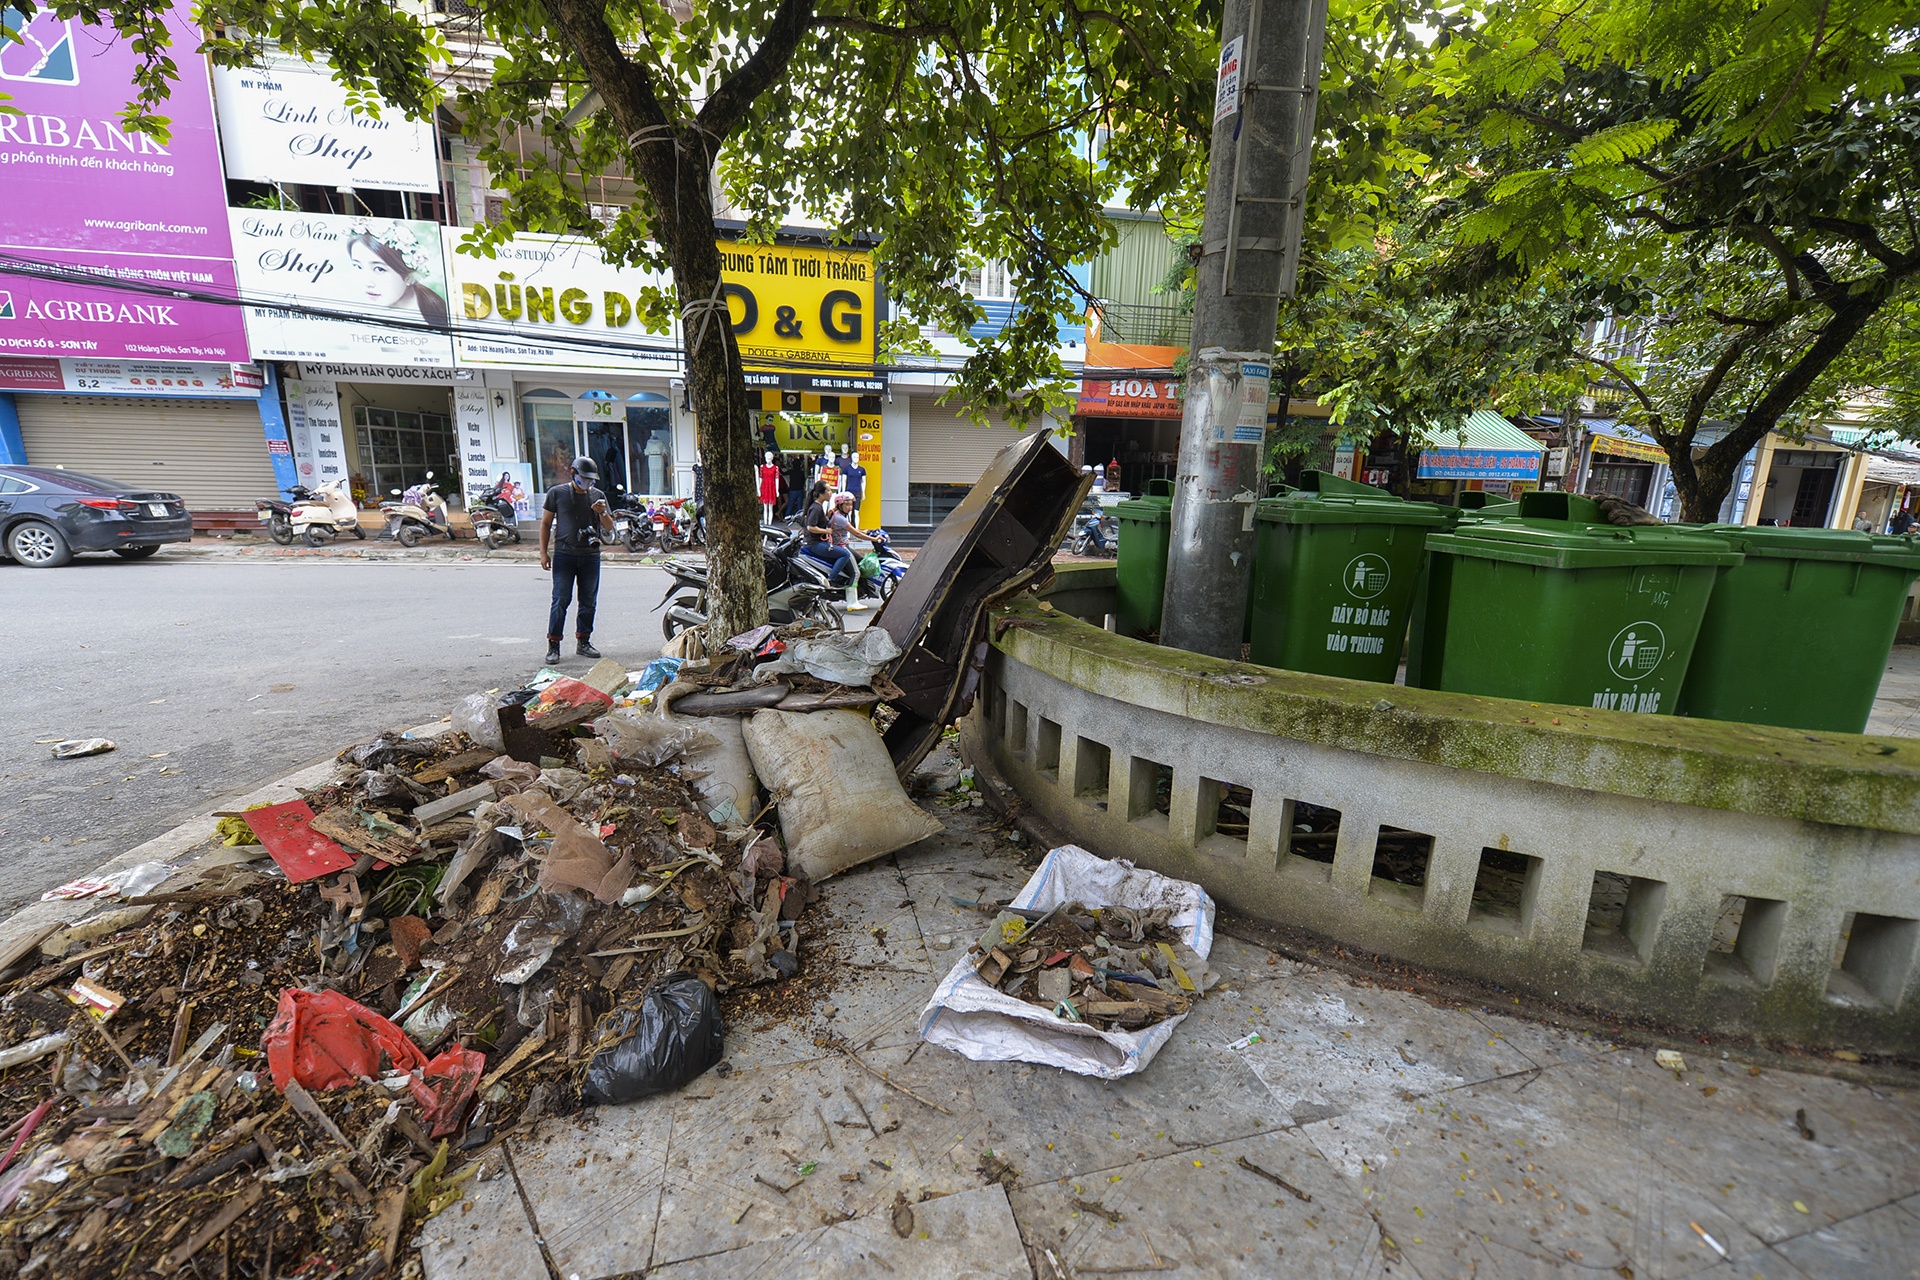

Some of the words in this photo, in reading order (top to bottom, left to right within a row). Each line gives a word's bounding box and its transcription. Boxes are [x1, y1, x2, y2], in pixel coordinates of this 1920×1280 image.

[289, 131, 373, 169] Shop
[11, 150, 44, 165] phồn
[46, 153, 78, 168] thịnh
[80, 155, 102, 169] đến
[105, 157, 142, 172] khách
[143, 161, 175, 177] hàng
[84, 217, 208, 235] www.agribank.com.vn
[242, 217, 283, 237] Linh
[515, 249, 555, 262] STUDIO
[258, 247, 334, 283] Shop
[758, 252, 788, 275] TÂM
[791, 254, 821, 278] THỜI
[826, 258, 867, 282] TRANG
[145, 269, 170, 282] THÔN
[170, 270, 191, 284] VIỆT
[191, 273, 214, 283] NAM
[461, 270, 593, 325] DŨNG
[24, 299, 179, 326] AGRIBANK
[774, 305, 803, 338] &
[820, 289, 862, 342] G
[8, 338, 32, 349] DỊCH
[33, 337, 46, 348] SỐ
[47, 340, 54, 348] 8
[60, 339, 80, 349] SƠN
[80, 340, 98, 350] TÂY
[125, 344, 137, 352] 102
[138, 345, 160, 355] Hoàng
[748, 348, 778, 358] DOLCE
[786, 349, 831, 361] GABBANA
[305, 362, 322, 374] MỸ
[360, 364, 385, 376] HÀN
[387, 365, 420, 379] QUỐC
[422, 367, 453, 380] XÁCH
[1242, 367, 1256, 376] TAXI
[78, 379, 100, 389] 8,2
[467, 422, 480, 433] Vichy
[860, 418, 880, 430] D&G
[467, 452, 486, 462] Laroche
[468, 467, 488, 477] Shiseido
[1331, 603, 1354, 624] HÃY
[1354, 601, 1369, 625] BỎ
[1370, 605, 1390, 626] RÁC
[1327, 630, 1348, 652] VÀO
[1350, 632, 1384, 654] THÙNG
[1592, 688, 1619, 710] HÃY
[1619, 684, 1637, 713] BỎ
[1637, 687, 1661, 713] RÁC
